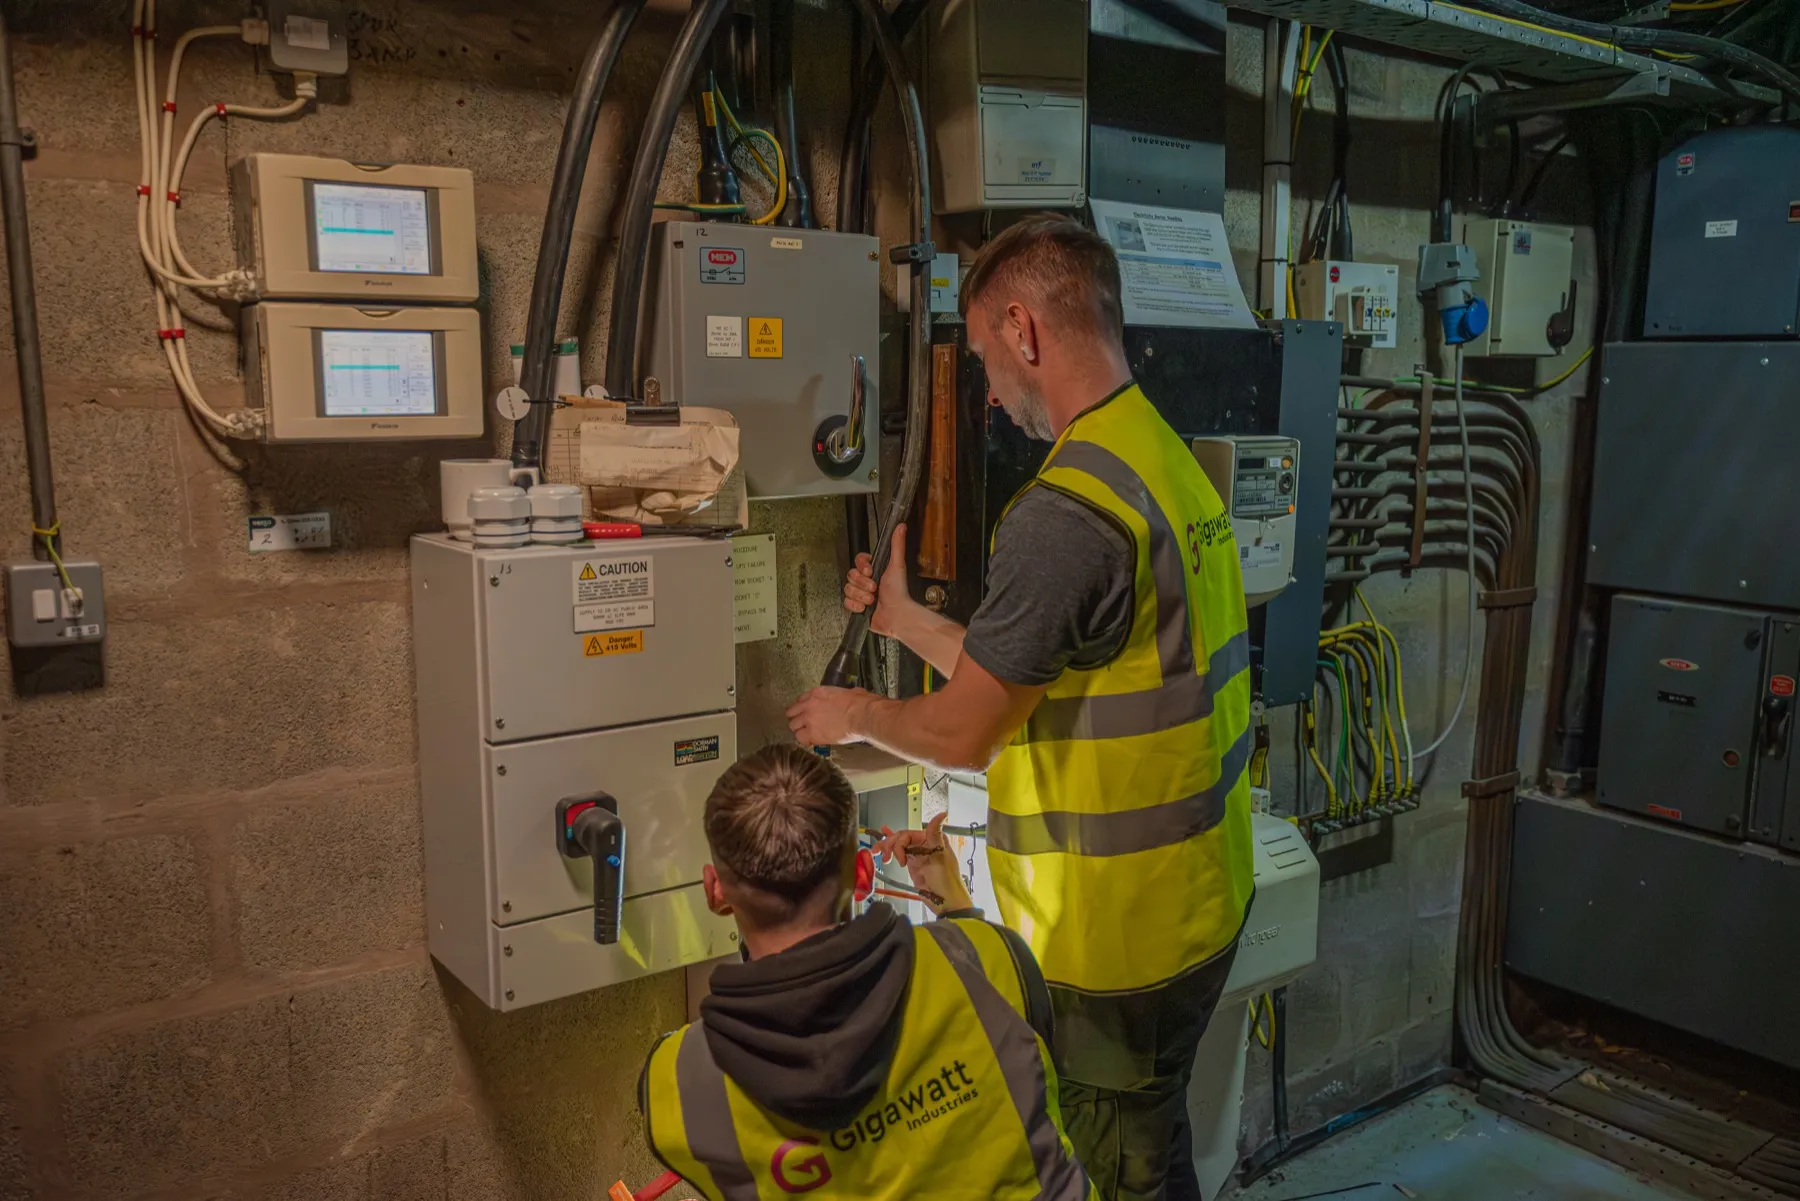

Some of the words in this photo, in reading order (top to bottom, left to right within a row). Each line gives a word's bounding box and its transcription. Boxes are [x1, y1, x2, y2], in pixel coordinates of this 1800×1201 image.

[696, 228, 708, 237] 12
[711, 253, 734, 262] MEM
[261, 532, 273, 545] 2
[599, 561, 648, 576] CAUTION
[608, 635, 634, 645] Danger
[605, 644, 619, 652] 415
[620, 641, 638, 650] Volts
[693, 737, 718, 747] DORMAN
[1238, 924, 1282, 949] itchgear
[829, 1059, 974, 1152] Gigawatt
[906, 1088, 979, 1131] Industries
